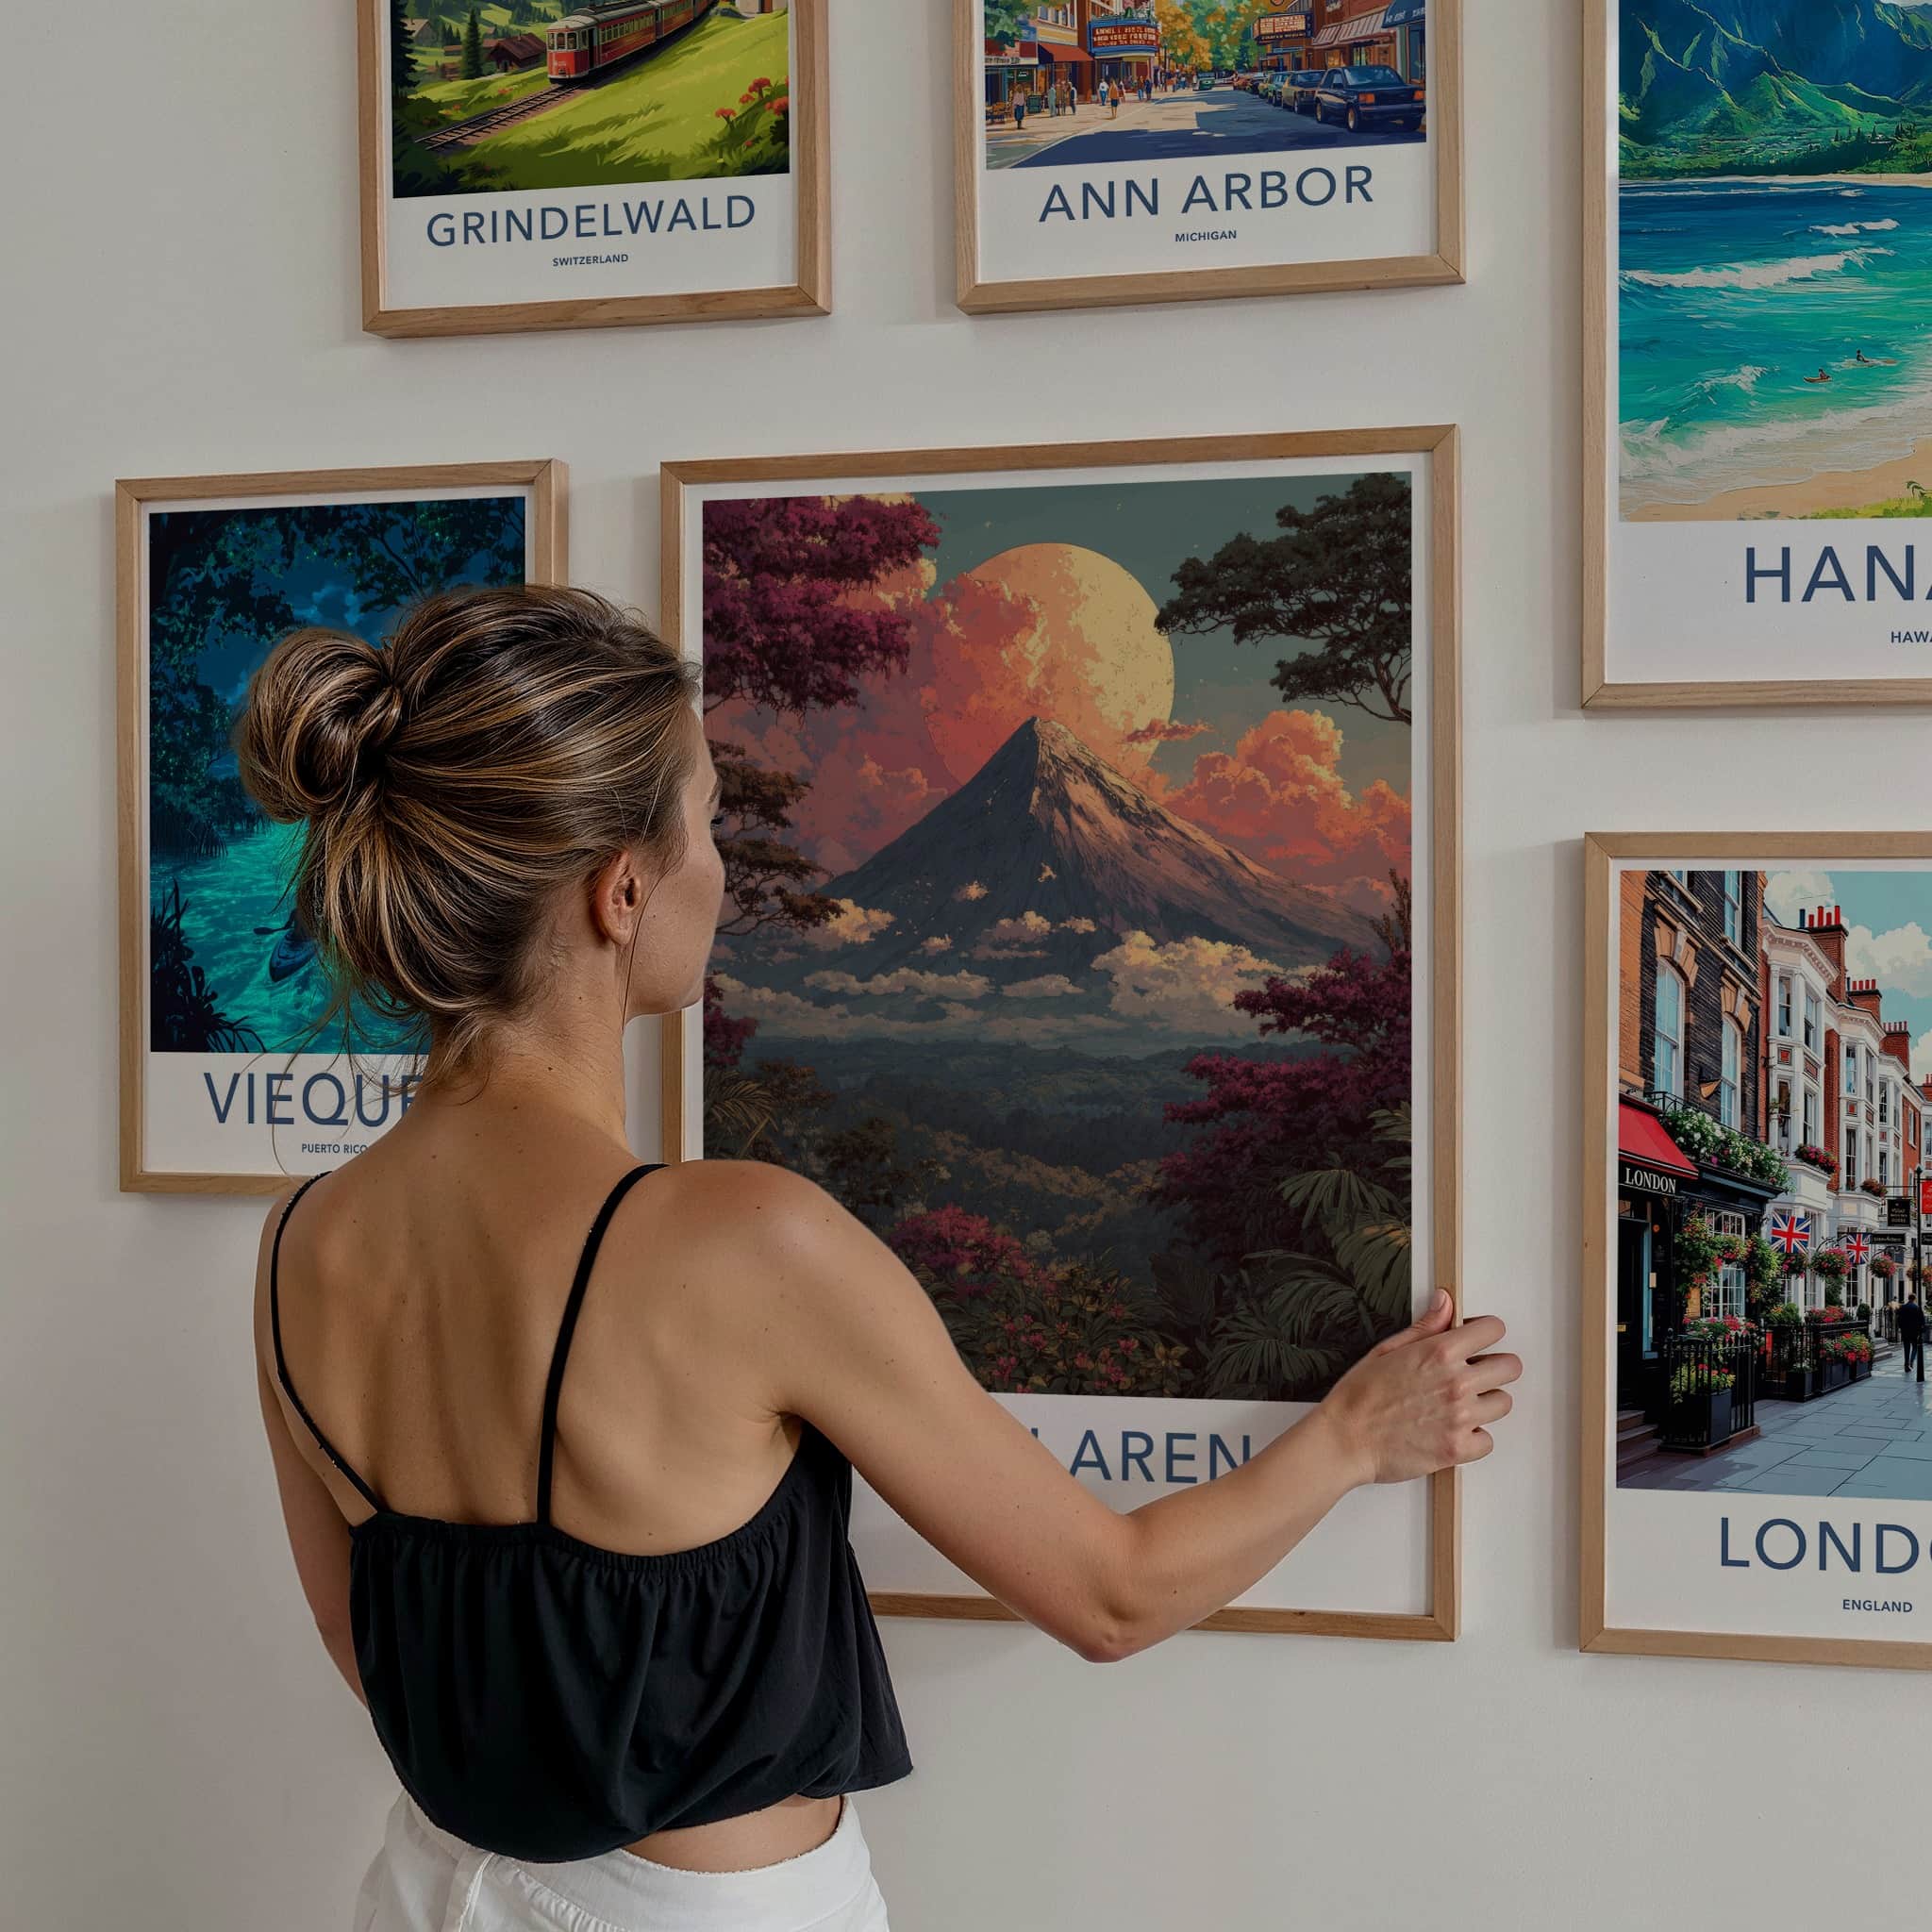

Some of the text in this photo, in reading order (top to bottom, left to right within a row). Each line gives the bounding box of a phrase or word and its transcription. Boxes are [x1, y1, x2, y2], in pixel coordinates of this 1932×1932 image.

[1039, 165, 1374, 223] ANN ARBOR
[426, 194, 756, 247] GRINDELWALD
[1174, 230, 1237, 242] MICHIGAN
[553, 254, 629, 267] SWITZERLAND
[1745, 544, 1932, 604] HAN
[1890, 630, 1932, 643] HAW
[301, 1143, 341, 1154] PUERTO
[1624, 1167, 1676, 1194] LONDON
[1721, 1517, 1932, 1574] LOND
[1842, 1599, 1913, 1613] ENGLAND
